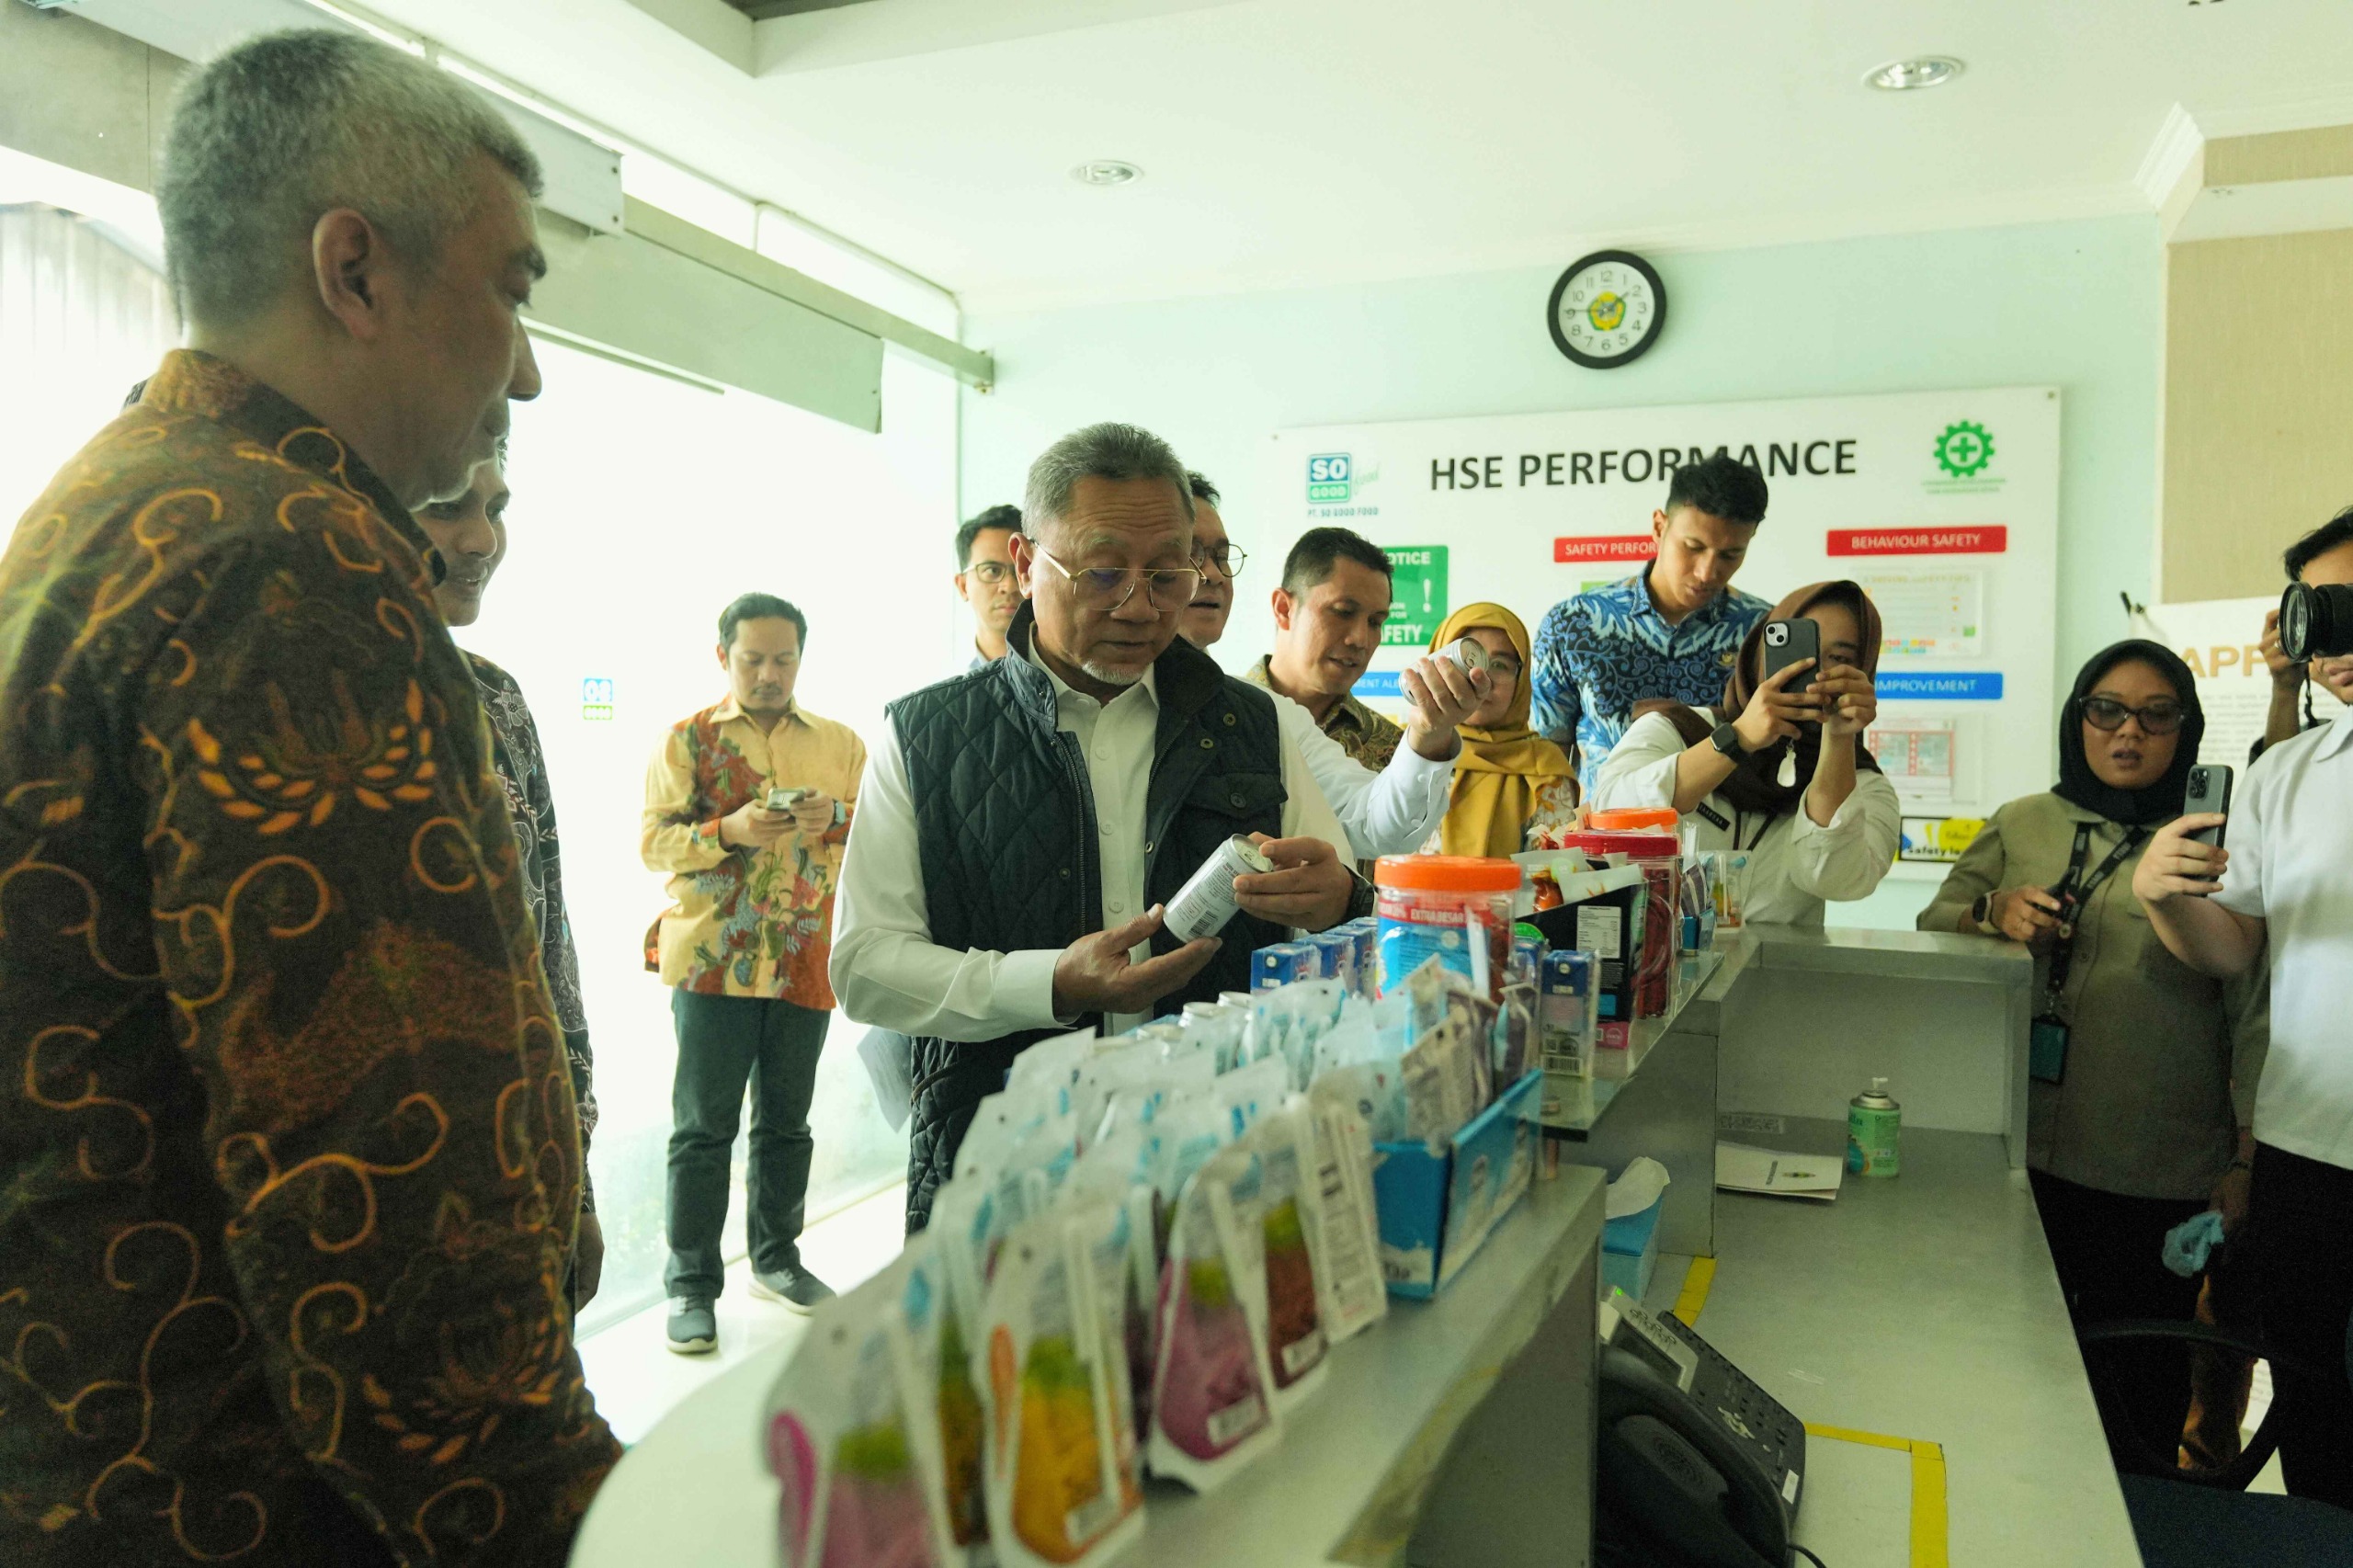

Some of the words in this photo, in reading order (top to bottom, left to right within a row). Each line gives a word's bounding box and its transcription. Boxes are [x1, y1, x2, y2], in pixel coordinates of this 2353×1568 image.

[1600, 270, 1612, 282] 12
[1572, 290, 1584, 302] 10
[1632, 285, 1641, 297] 2
[1637, 301, 1647, 313] 3
[1572, 324, 1581, 335] 8
[1631, 320, 1641, 331] 4
[1585, 335, 1593, 347] 7
[1601, 339, 1610, 350] 6
[1619, 334, 1628, 345] 5
[1311, 459, 1347, 481] SO
[1431, 457, 1503, 491] HSE
[1851, 534, 1929, 550] BEHAVIOUR
[1932, 532, 1981, 548] SAFETY
[1565, 543, 1608, 556] SAFETY
[1610, 541, 1656, 555] PERFOR
[1386, 551, 1431, 565] OTICE
[1381, 624, 1423, 642] FETY
[1875, 678, 1978, 692] IMPROVEMENT
